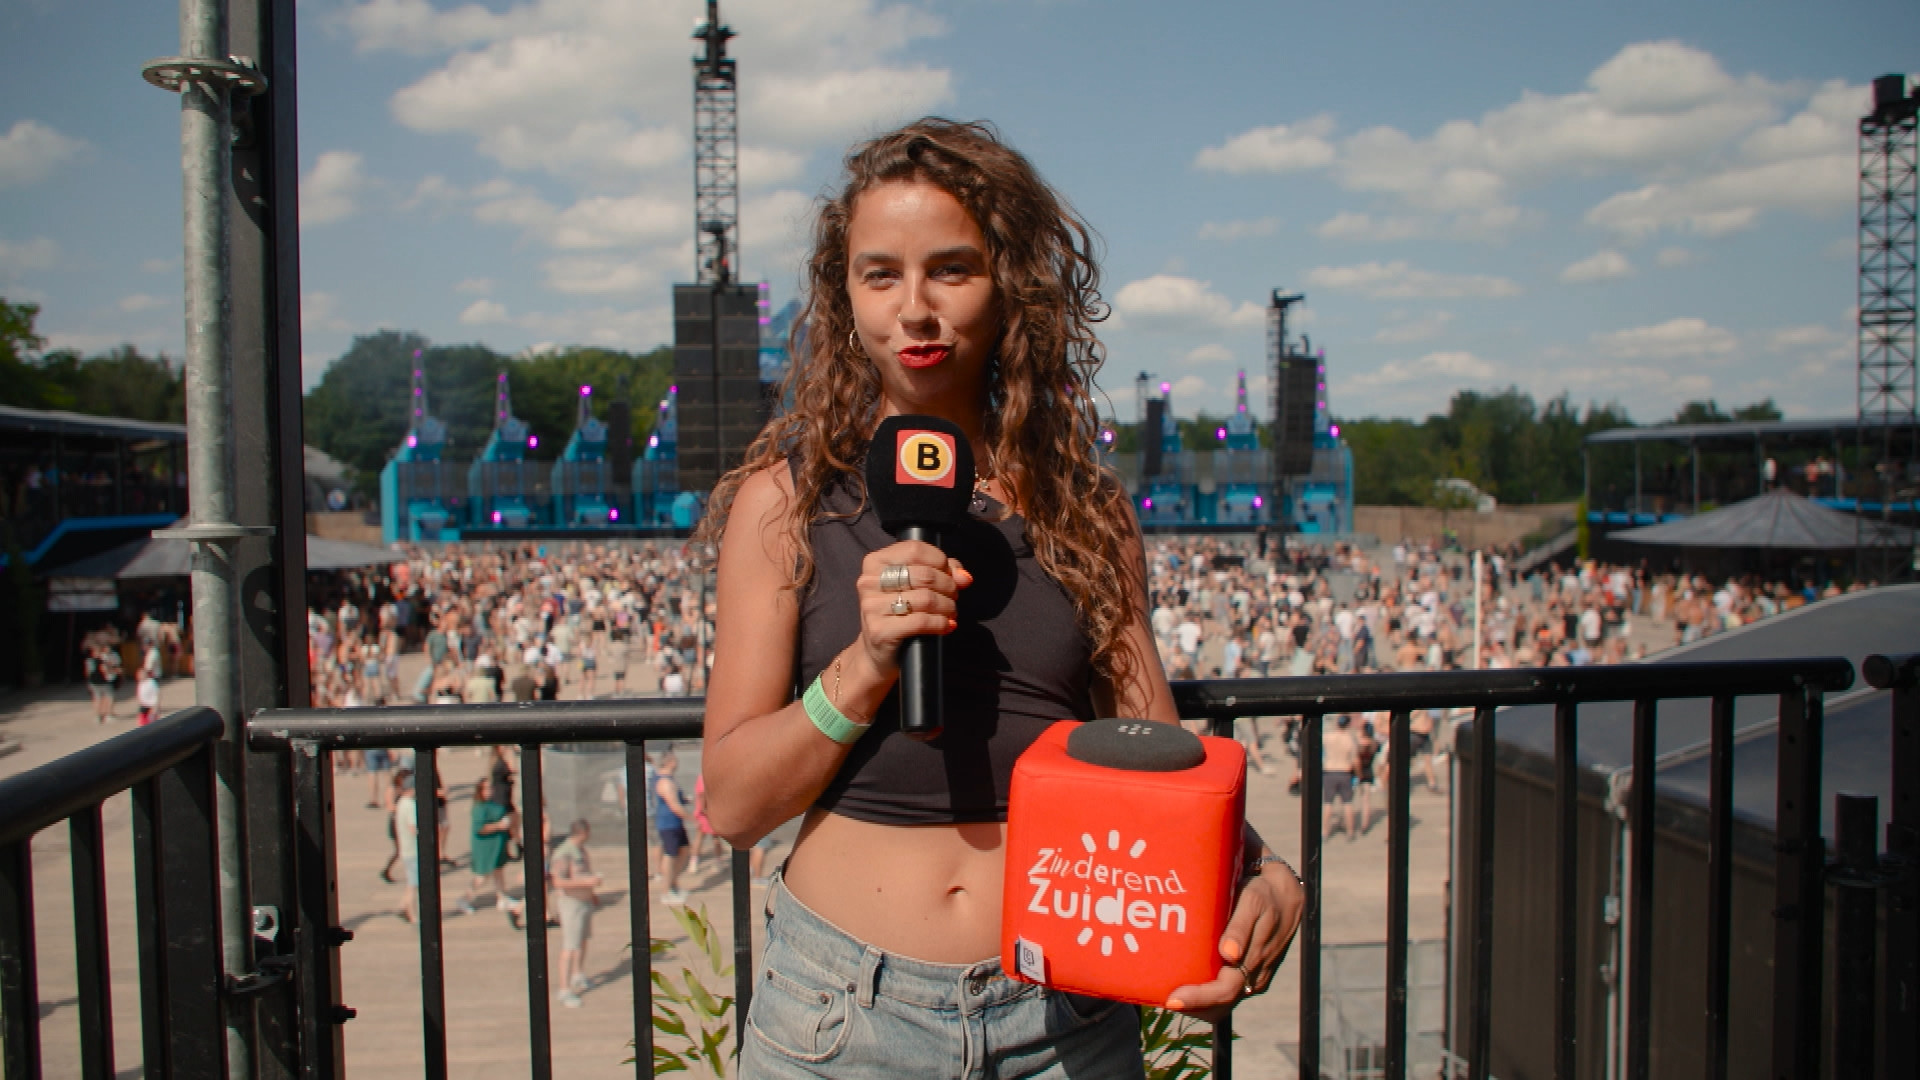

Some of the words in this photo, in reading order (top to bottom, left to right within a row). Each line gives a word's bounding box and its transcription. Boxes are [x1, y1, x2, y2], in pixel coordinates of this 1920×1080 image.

[917, 443, 941, 471] B
[1027, 847, 1188, 895] Zinderend
[1027, 875, 1187, 934] Zuiden
